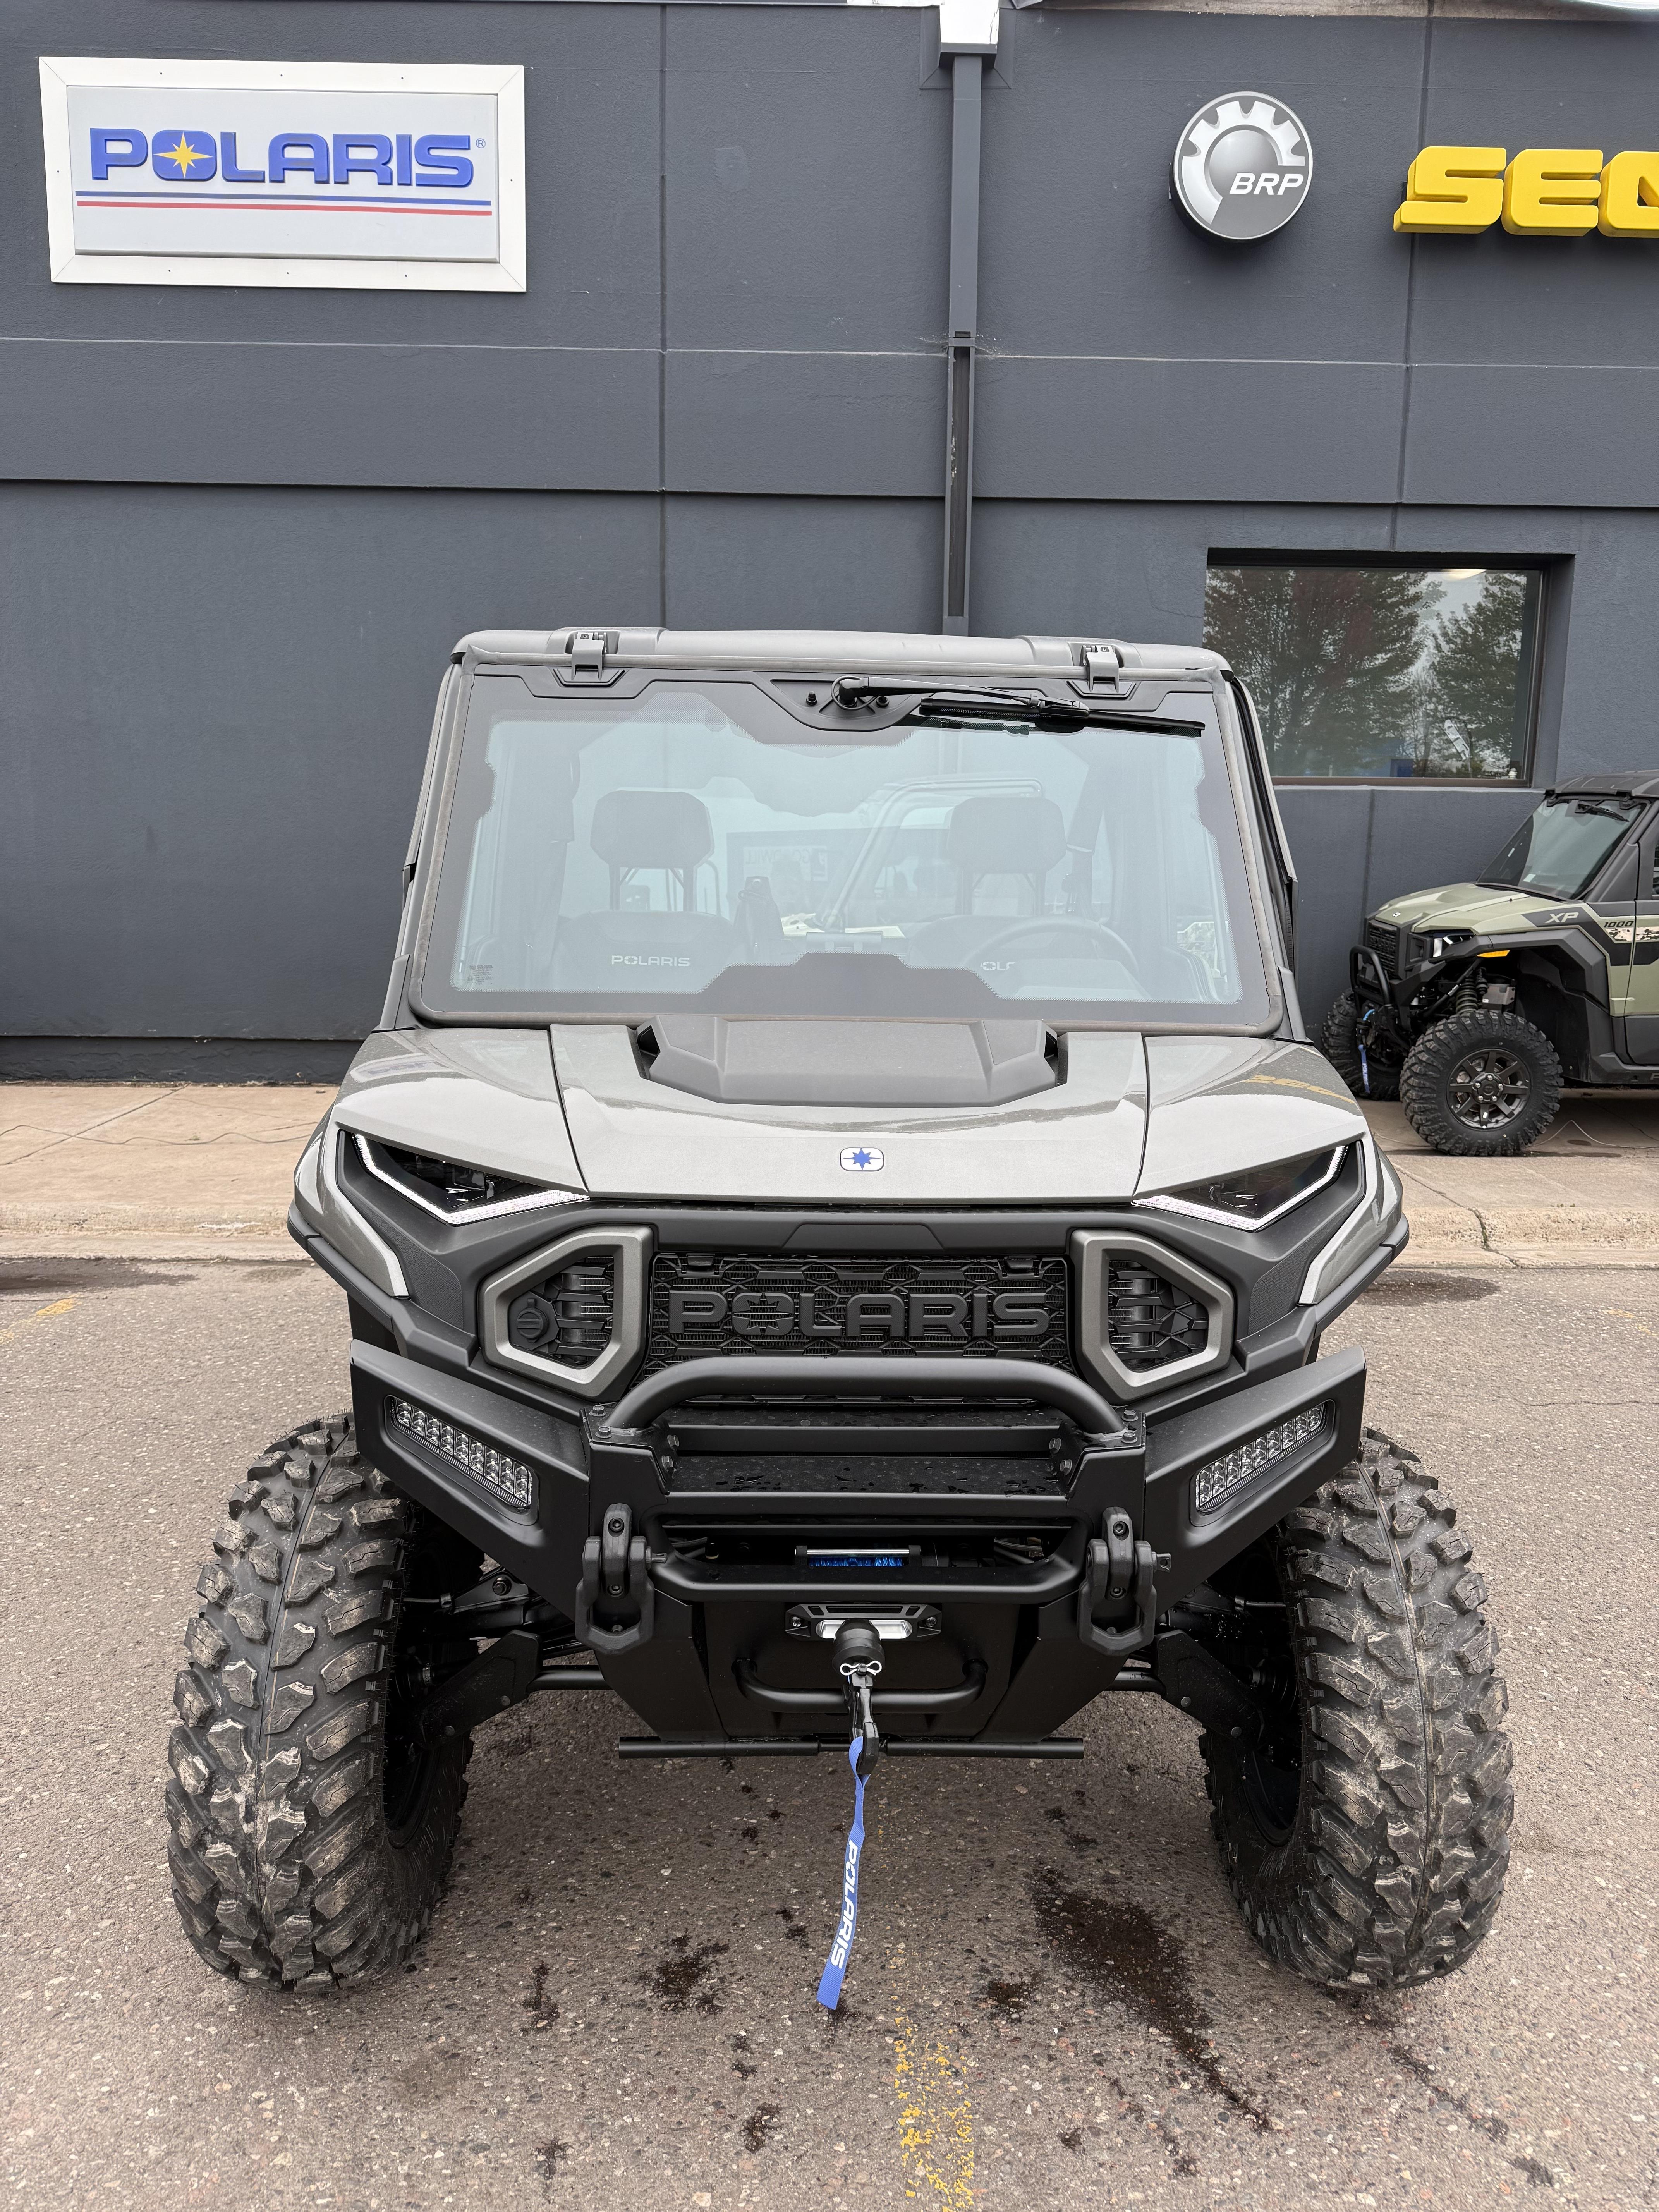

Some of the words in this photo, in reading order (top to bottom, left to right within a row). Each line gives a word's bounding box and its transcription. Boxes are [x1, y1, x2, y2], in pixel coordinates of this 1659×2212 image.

[1229, 172, 1304, 196] BRP
[1544, 912, 1579, 924] XP
[611, 955, 690, 967] POLARIS
[668, 1289, 1050, 1337] POLARIS
[831, 1840, 858, 1969] POLARIS
